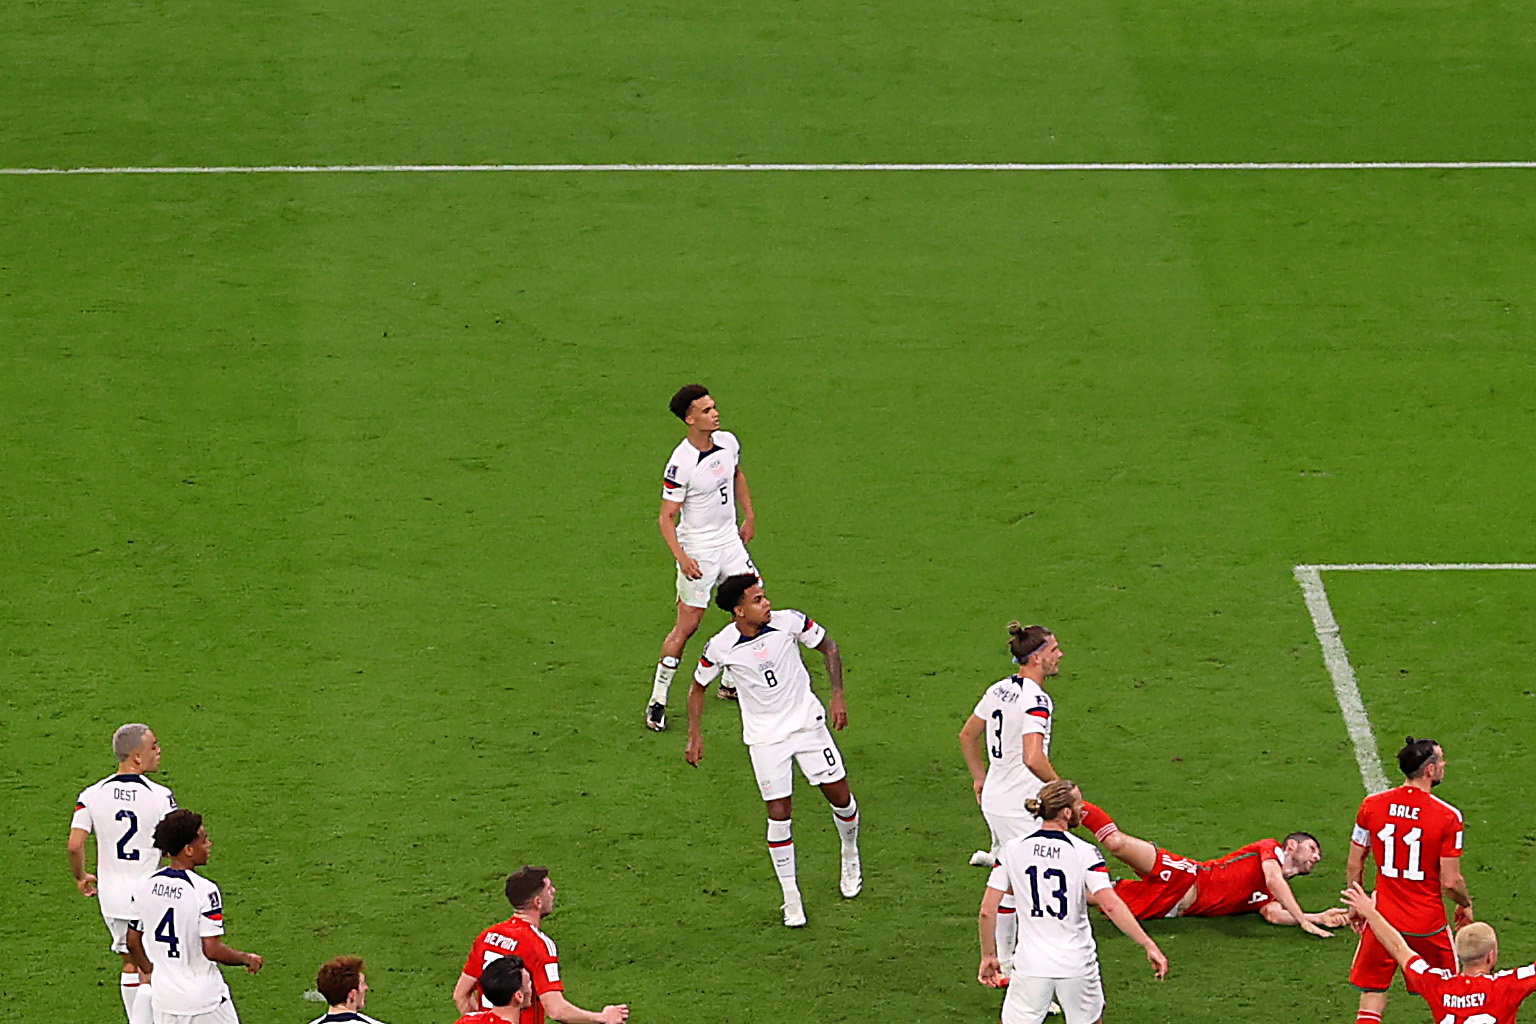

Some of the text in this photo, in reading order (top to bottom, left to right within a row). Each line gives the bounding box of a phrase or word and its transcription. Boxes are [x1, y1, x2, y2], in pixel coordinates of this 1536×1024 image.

[719, 486, 729, 506] 5
[764, 669, 779, 689] 8
[991, 708, 1004, 760] 3
[823, 747, 837, 767] 8
[113, 787, 138, 802] DEST
[1388, 803, 1421, 821] BALE
[115, 809, 140, 861] 2
[1033, 843, 1061, 860] REAM
[1376, 823, 1425, 882] 11
[151, 882, 184, 900] ADAMS
[1025, 865, 1068, 920] 13
[155, 907, 181, 959] 4
[1442, 992, 1487, 1009] RAMSEY
